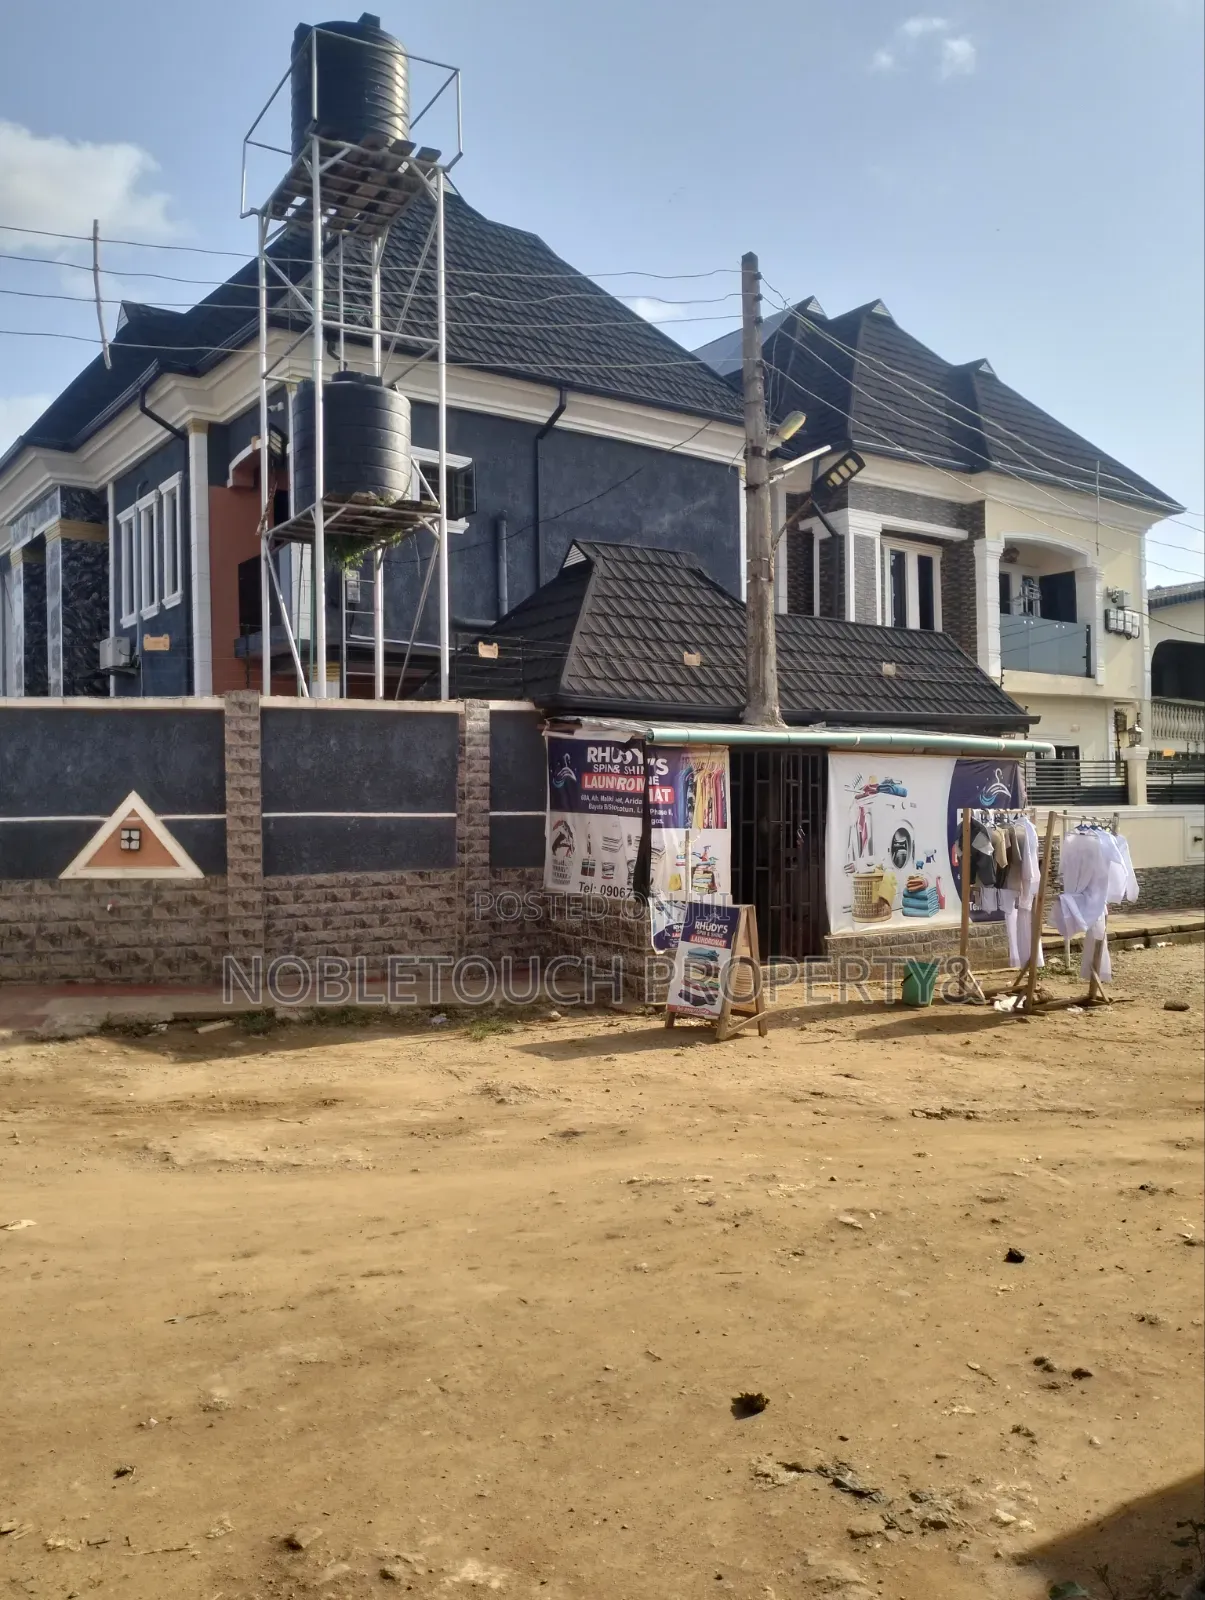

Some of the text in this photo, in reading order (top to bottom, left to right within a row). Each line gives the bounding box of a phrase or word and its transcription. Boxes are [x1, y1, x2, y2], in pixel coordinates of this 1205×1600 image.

[593, 764, 613, 773] SPIN
[612, 765, 620, 774] &
[585, 775, 671, 802] LAUNROMAT
[579, 881, 597, 895] Tel:
[694, 920, 729, 934] RHUDY'S
